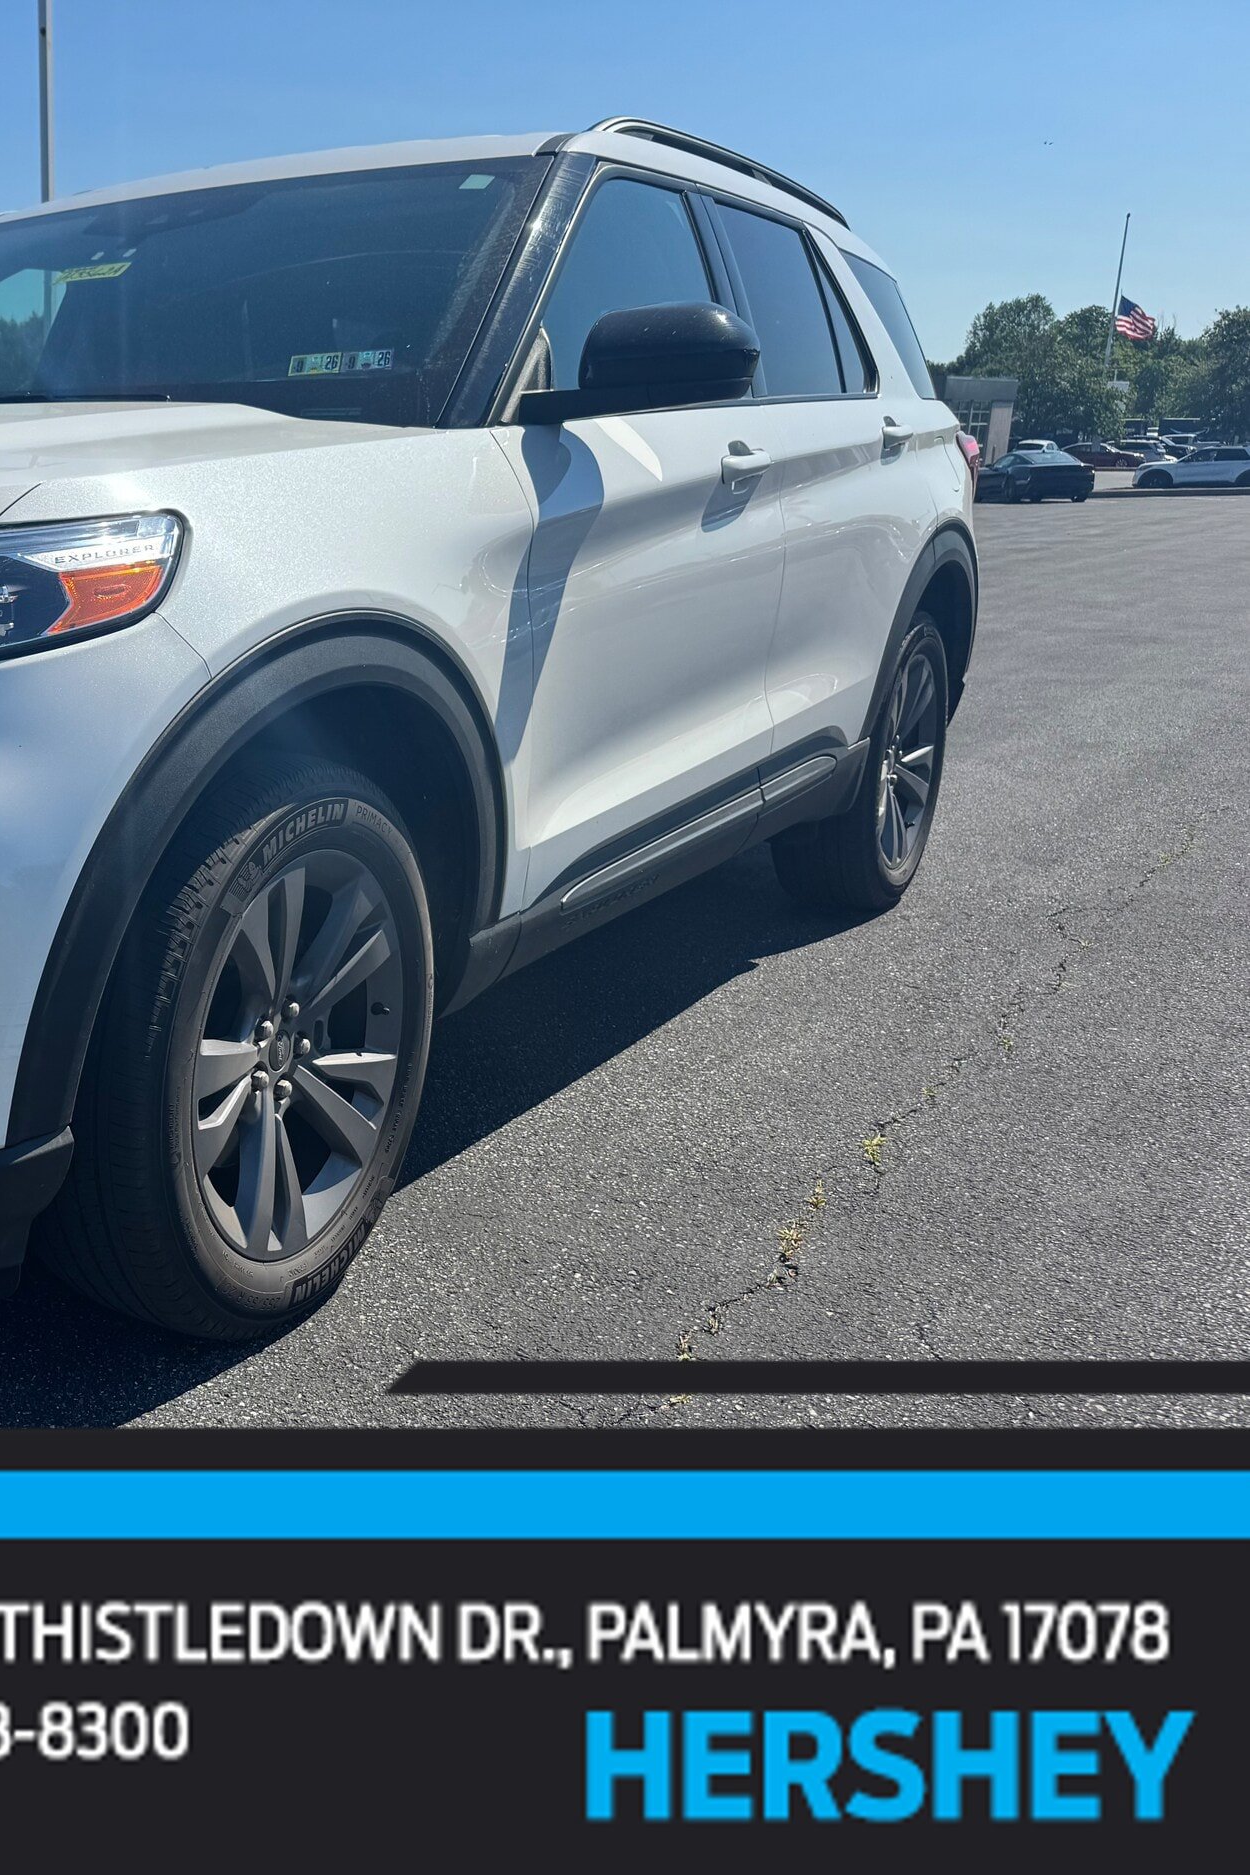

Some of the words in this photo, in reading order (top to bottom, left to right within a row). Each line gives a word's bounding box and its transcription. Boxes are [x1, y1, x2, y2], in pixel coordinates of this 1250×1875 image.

[325, 355, 339, 370] 26
[377, 351, 391, 367] 26
[54, 543, 155, 565] EXPLORER
[262, 802, 345, 866] MICHELIN
[355, 804, 394, 836] PRIMACY
[293, 1223, 365, 1304] MICHELIN
